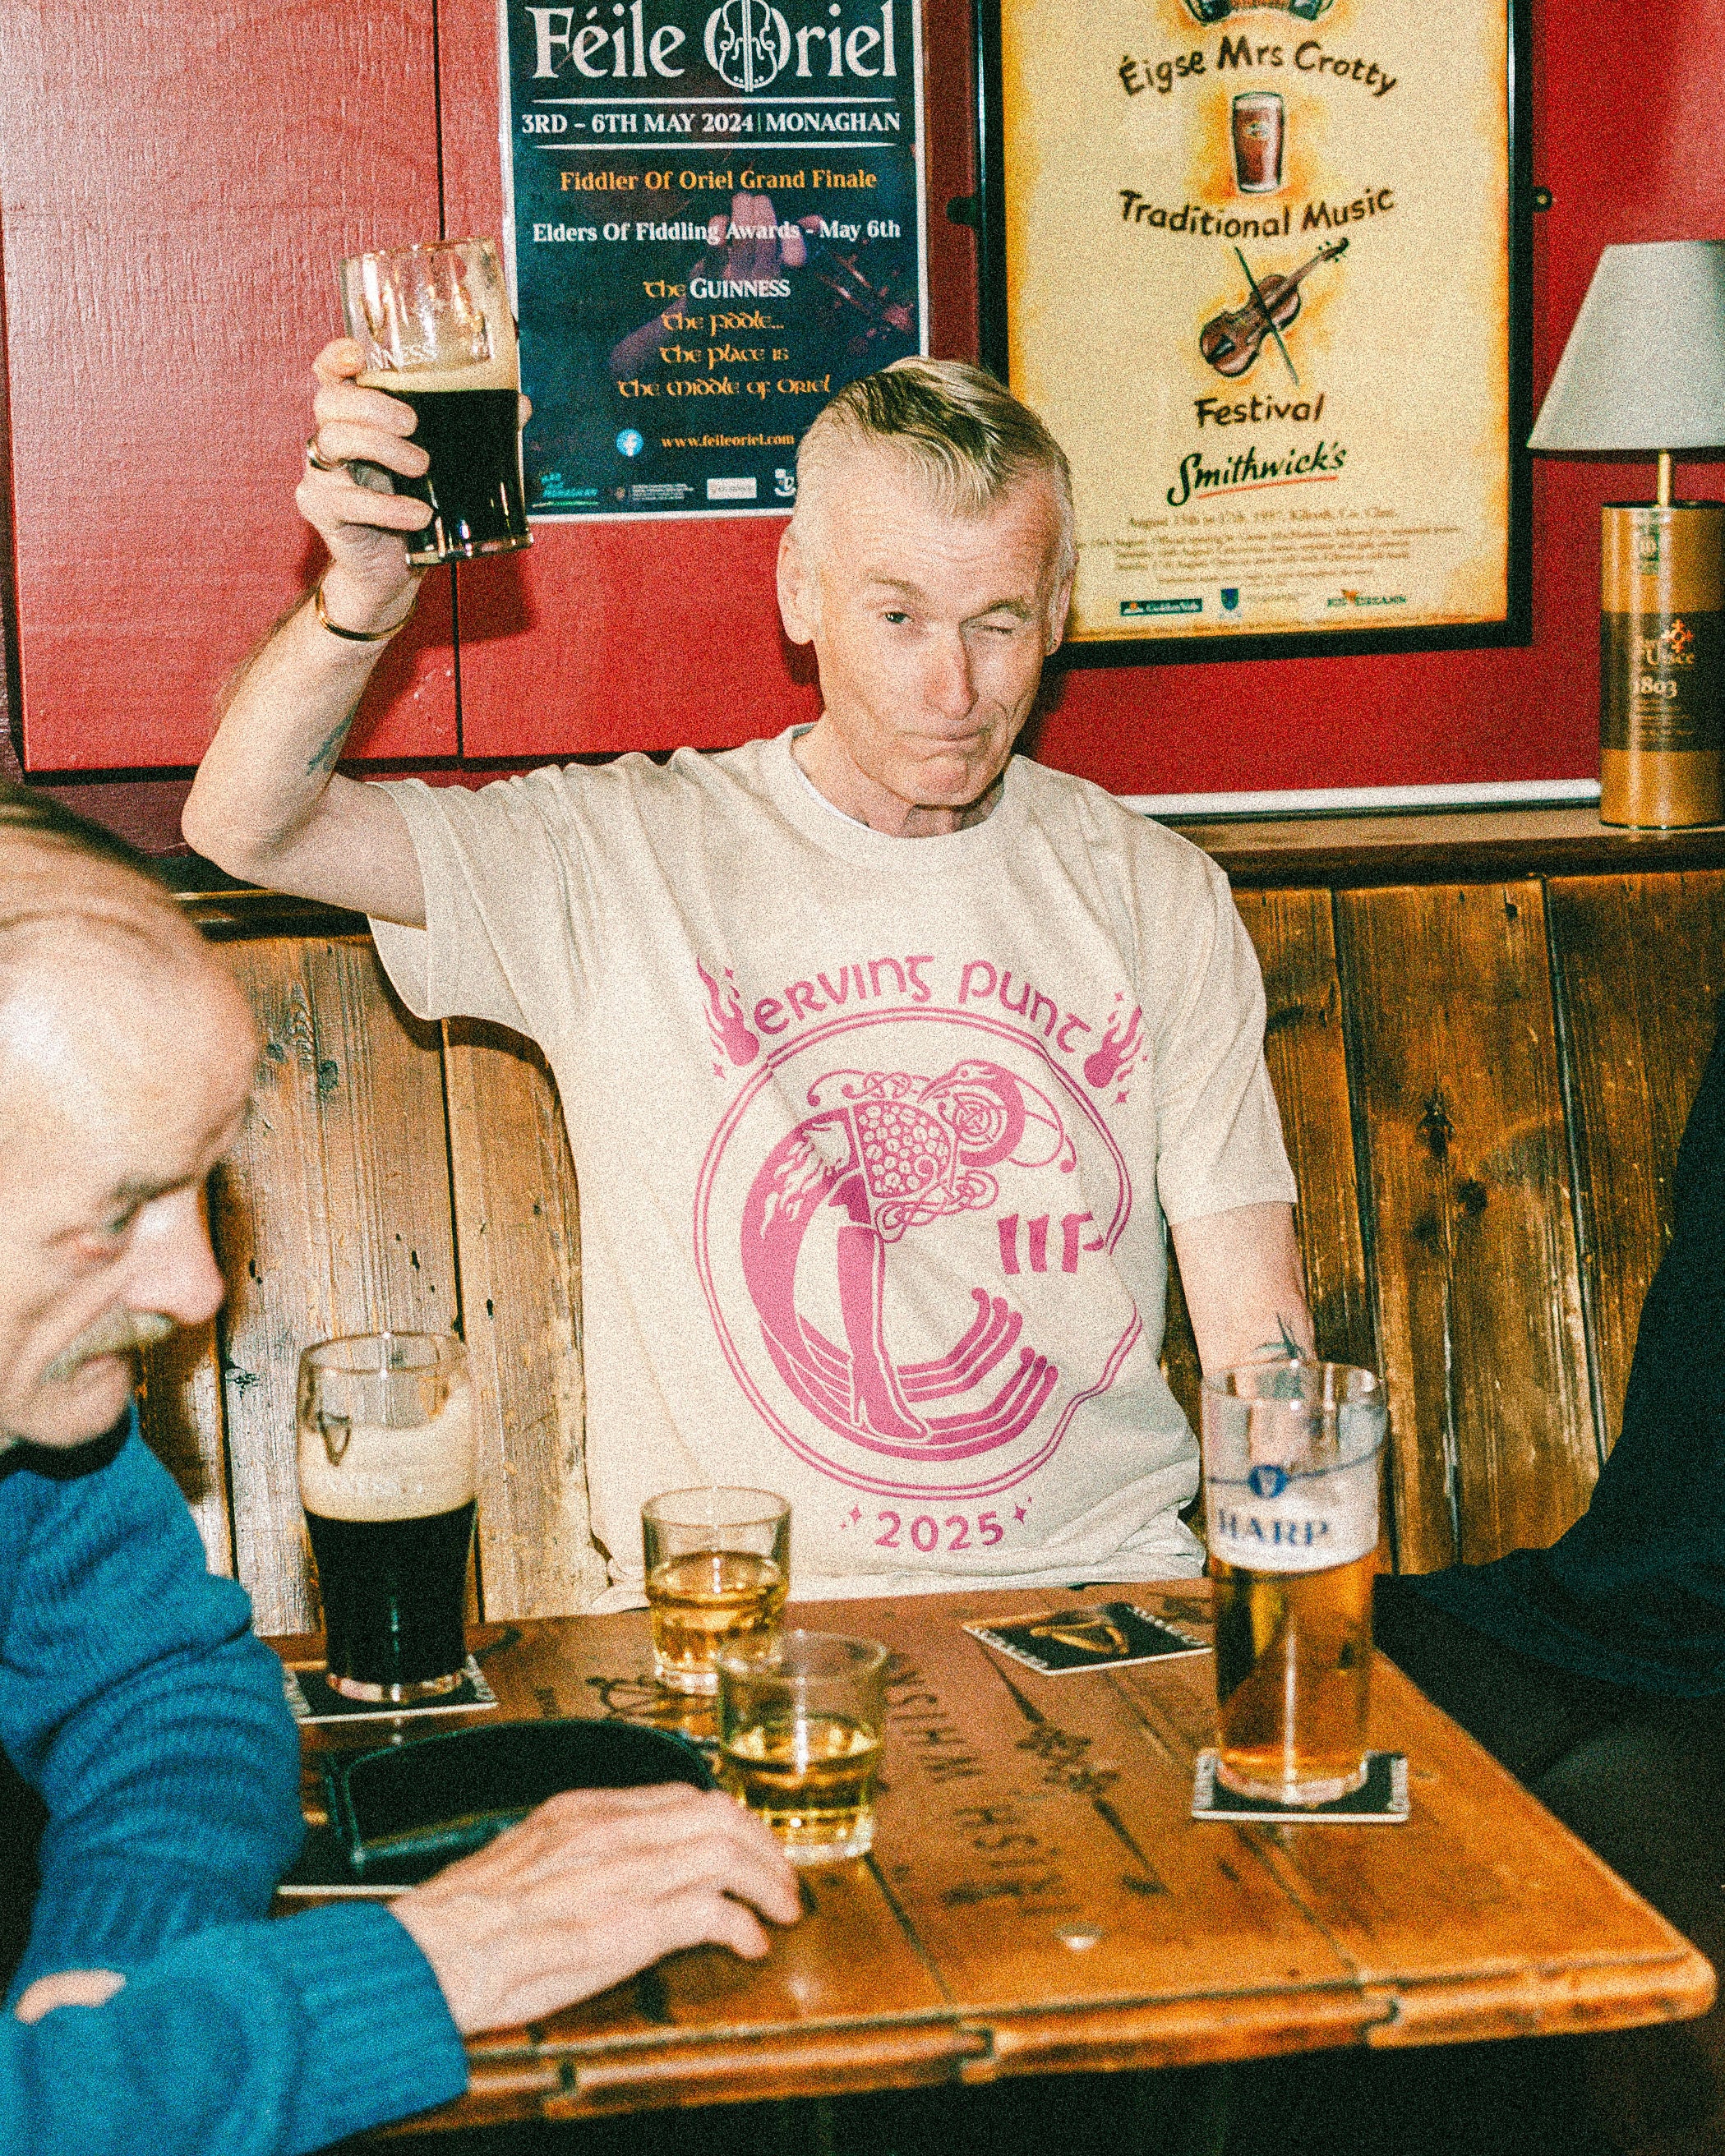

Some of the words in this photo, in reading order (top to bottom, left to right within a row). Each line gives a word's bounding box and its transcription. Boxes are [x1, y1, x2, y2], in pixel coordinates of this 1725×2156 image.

[524, 2, 687, 79] Féile
[703, 2, 897, 80] Oriel
[1215, 35, 1283, 71] Mrs
[1294, 39, 1398, 98] Crotty
[521, 113, 568, 135] 3RD
[592, 113, 638, 134] 6TH
[643, 112, 696, 133] MAY
[703, 111, 754, 133] 2024
[765, 110, 902, 133] MONAGHAN
[560, 170, 639, 192] Fiddler
[644, 168, 674, 191] Of
[678, 170, 734, 191] Oriel
[739, 168, 807, 190] Grand
[812, 168, 879, 189] Finale
[1118, 189, 1290, 238] Traditional
[1301, 187, 1395, 231] Music
[533, 222, 598, 243] Elders
[602, 222, 632, 242] Of
[636, 221, 719, 246] Fiddling
[724, 220, 800, 242] Awards
[819, 221, 863, 244] May
[868, 219, 902, 239] 6th
[689, 279, 791, 298] GUINNESS
[1192, 392, 1326, 428] Festival
[661, 435, 796, 449] www.feileoriel.com
[1165, 440, 1348, 507] Smithwick's
[874, 1510, 1005, 1553] 2025
[1219, 1509, 1329, 1546] HARP
